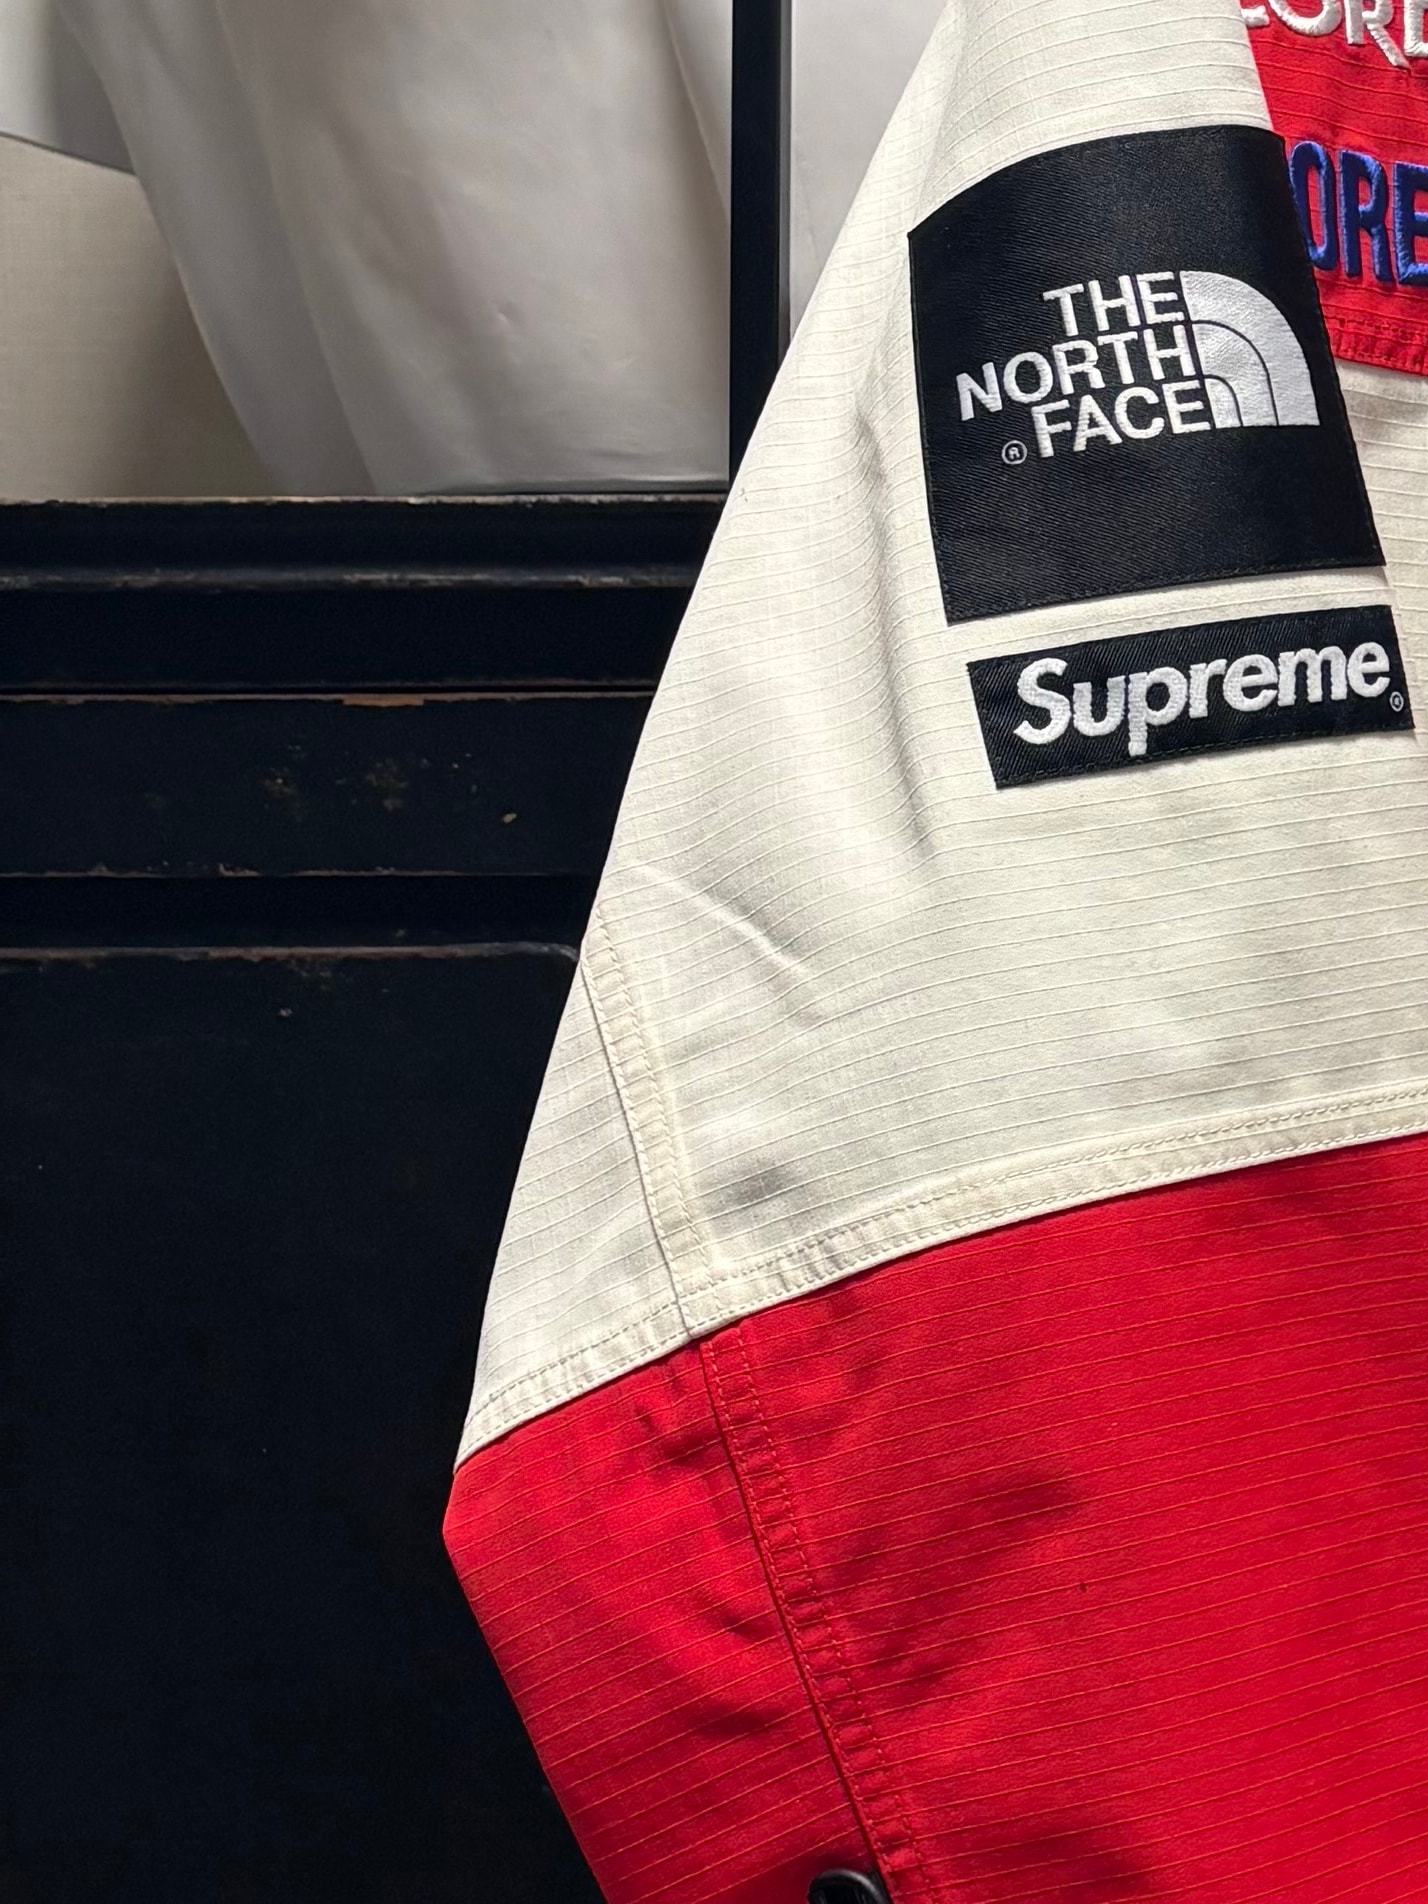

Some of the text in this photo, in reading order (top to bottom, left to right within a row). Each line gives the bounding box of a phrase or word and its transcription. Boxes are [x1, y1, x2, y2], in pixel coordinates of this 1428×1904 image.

[1043, 271, 1185, 336] THE
[956, 324, 1197, 422] NORTH
[1032, 380, 1214, 457] FACE
[1013, 641, 1391, 756] Supreme
